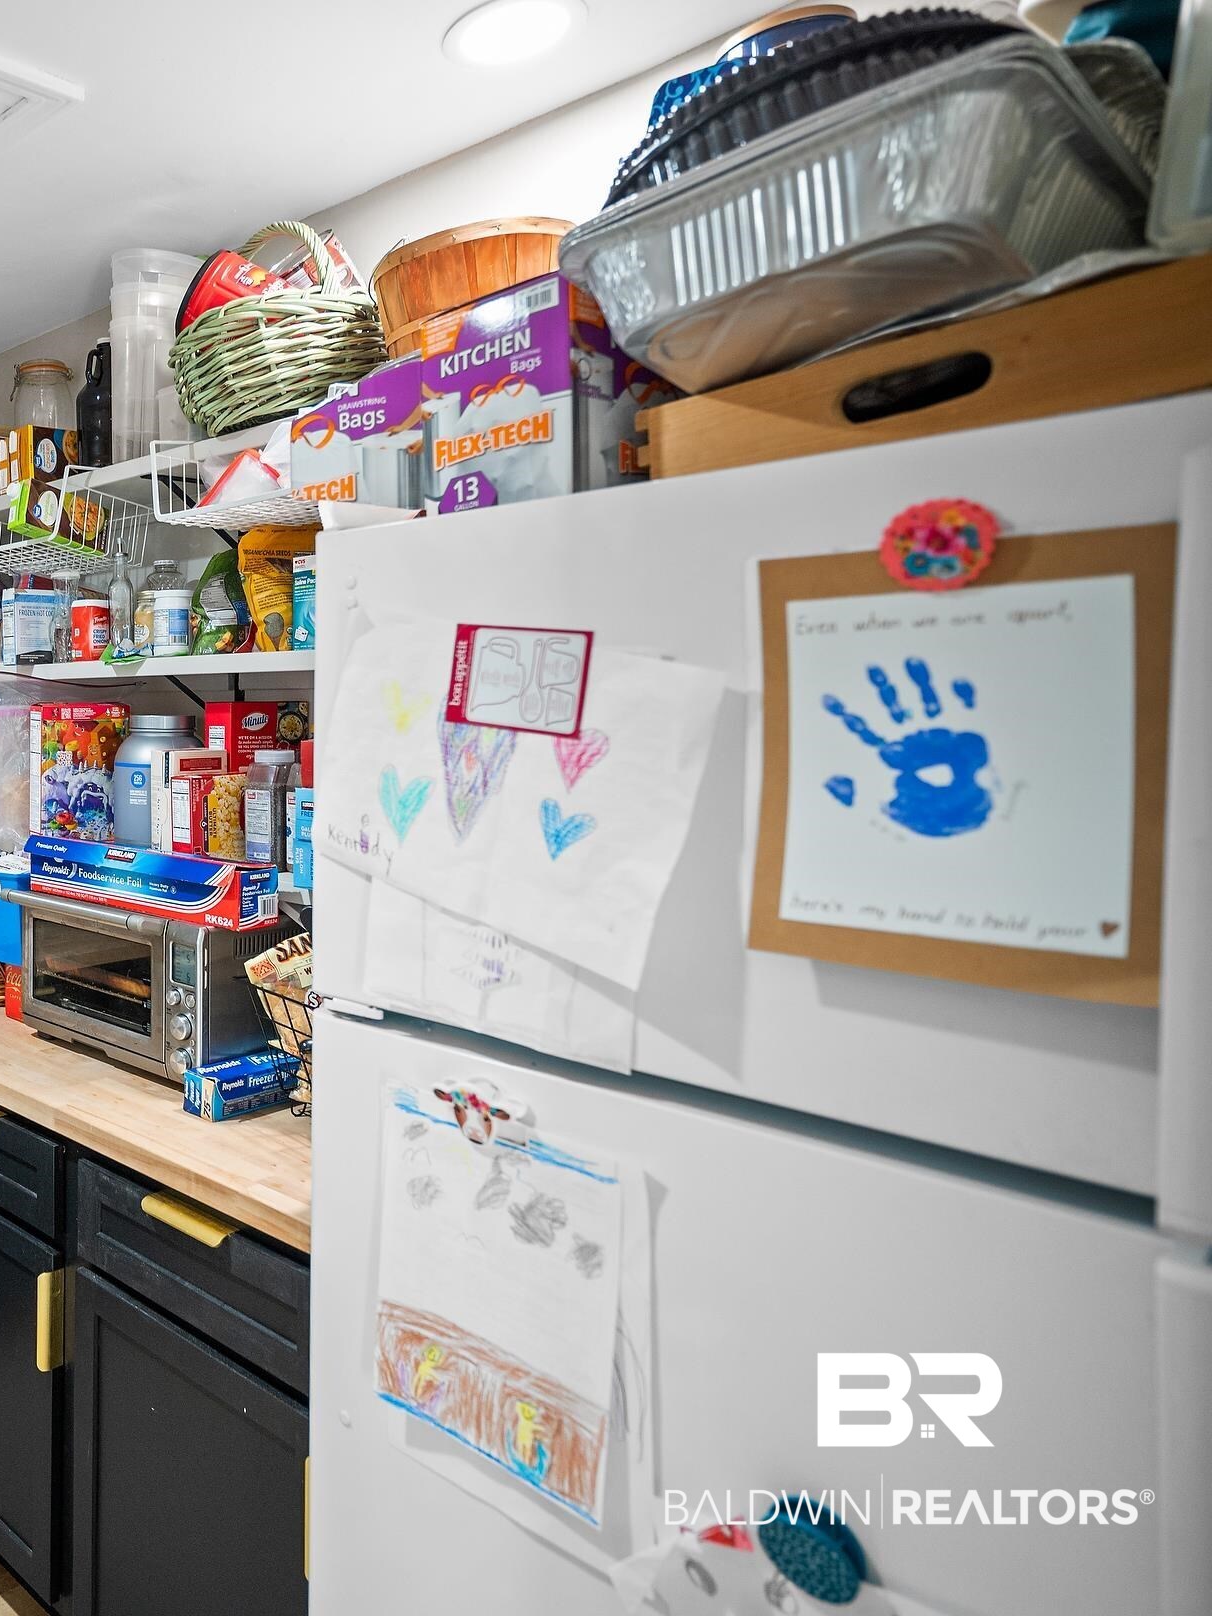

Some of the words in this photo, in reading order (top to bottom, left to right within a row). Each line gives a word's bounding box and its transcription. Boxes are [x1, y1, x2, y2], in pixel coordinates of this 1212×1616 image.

[440, 327, 532, 378] KITCHEN
[510, 356, 542, 375] Bags
[337, 396, 387, 413] DRAWSTRING
[338, 409, 386, 431] Bags
[434, 409, 553, 472] FLEX-TECH
[453, 476, 479, 504] 13
[454, 501, 479, 512] GALLON
[263, 549, 275, 557] CHIA
[275, 549, 291, 557] SEEDS
[19, 609, 37, 617] FROZEN
[853, 611, 901, 633] when
[912, 615, 938, 629] we
[950, 613, 986, 627] are
[449, 681, 463, 706] bon
[243, 713, 269, 728] Minute
[36, 841, 53, 850] Premium
[53, 844, 68, 854] Quality
[108, 849, 135, 859] KIRKLAND
[42, 862, 70, 876] Reynolds
[78, 867, 125, 886] Foodservice
[126, 876, 142, 888] Foil
[250, 872, 270, 880] KIRKLAND
[858, 902, 886, 921] my
[204, 913, 234, 928] RK624
[303, 966, 312, 976] W
[197, 1059, 242, 1074] Reynolds
[222, 1079, 245, 1092] Reynolds
[248, 1073, 275, 1088] Freezer
[203, 1101, 211, 1118] 75
